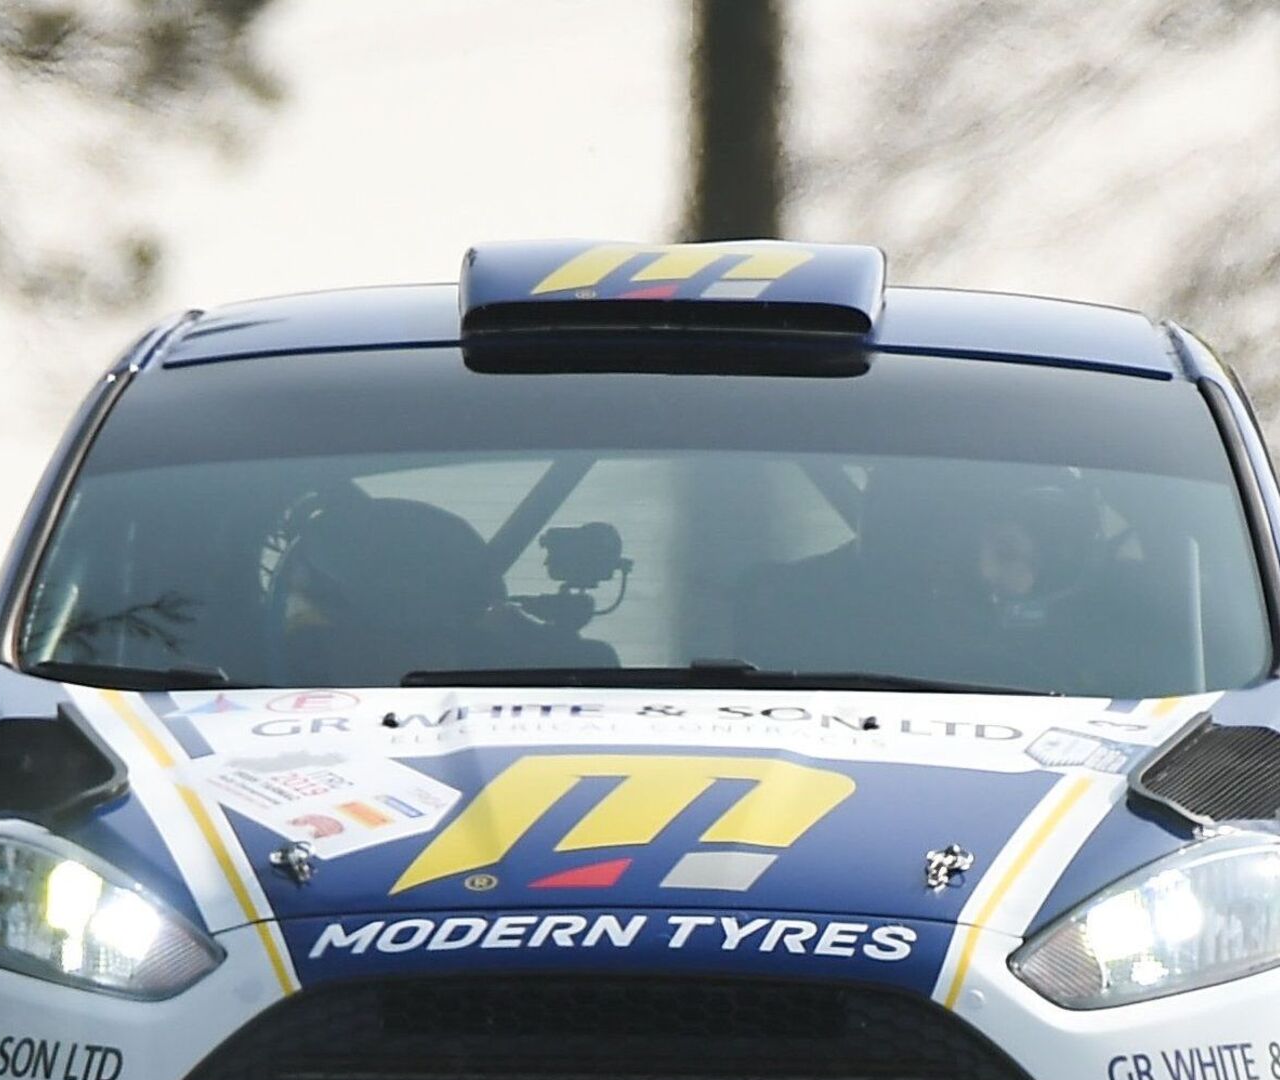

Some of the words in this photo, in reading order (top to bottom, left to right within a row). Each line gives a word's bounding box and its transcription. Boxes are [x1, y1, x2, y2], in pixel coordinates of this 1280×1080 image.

[251, 716, 352, 738] GR
[636, 704, 688, 718] &
[900, 718, 1023, 741] LTD
[308, 914, 648, 959] MODERN
[667, 915, 918, 961] TYRES
